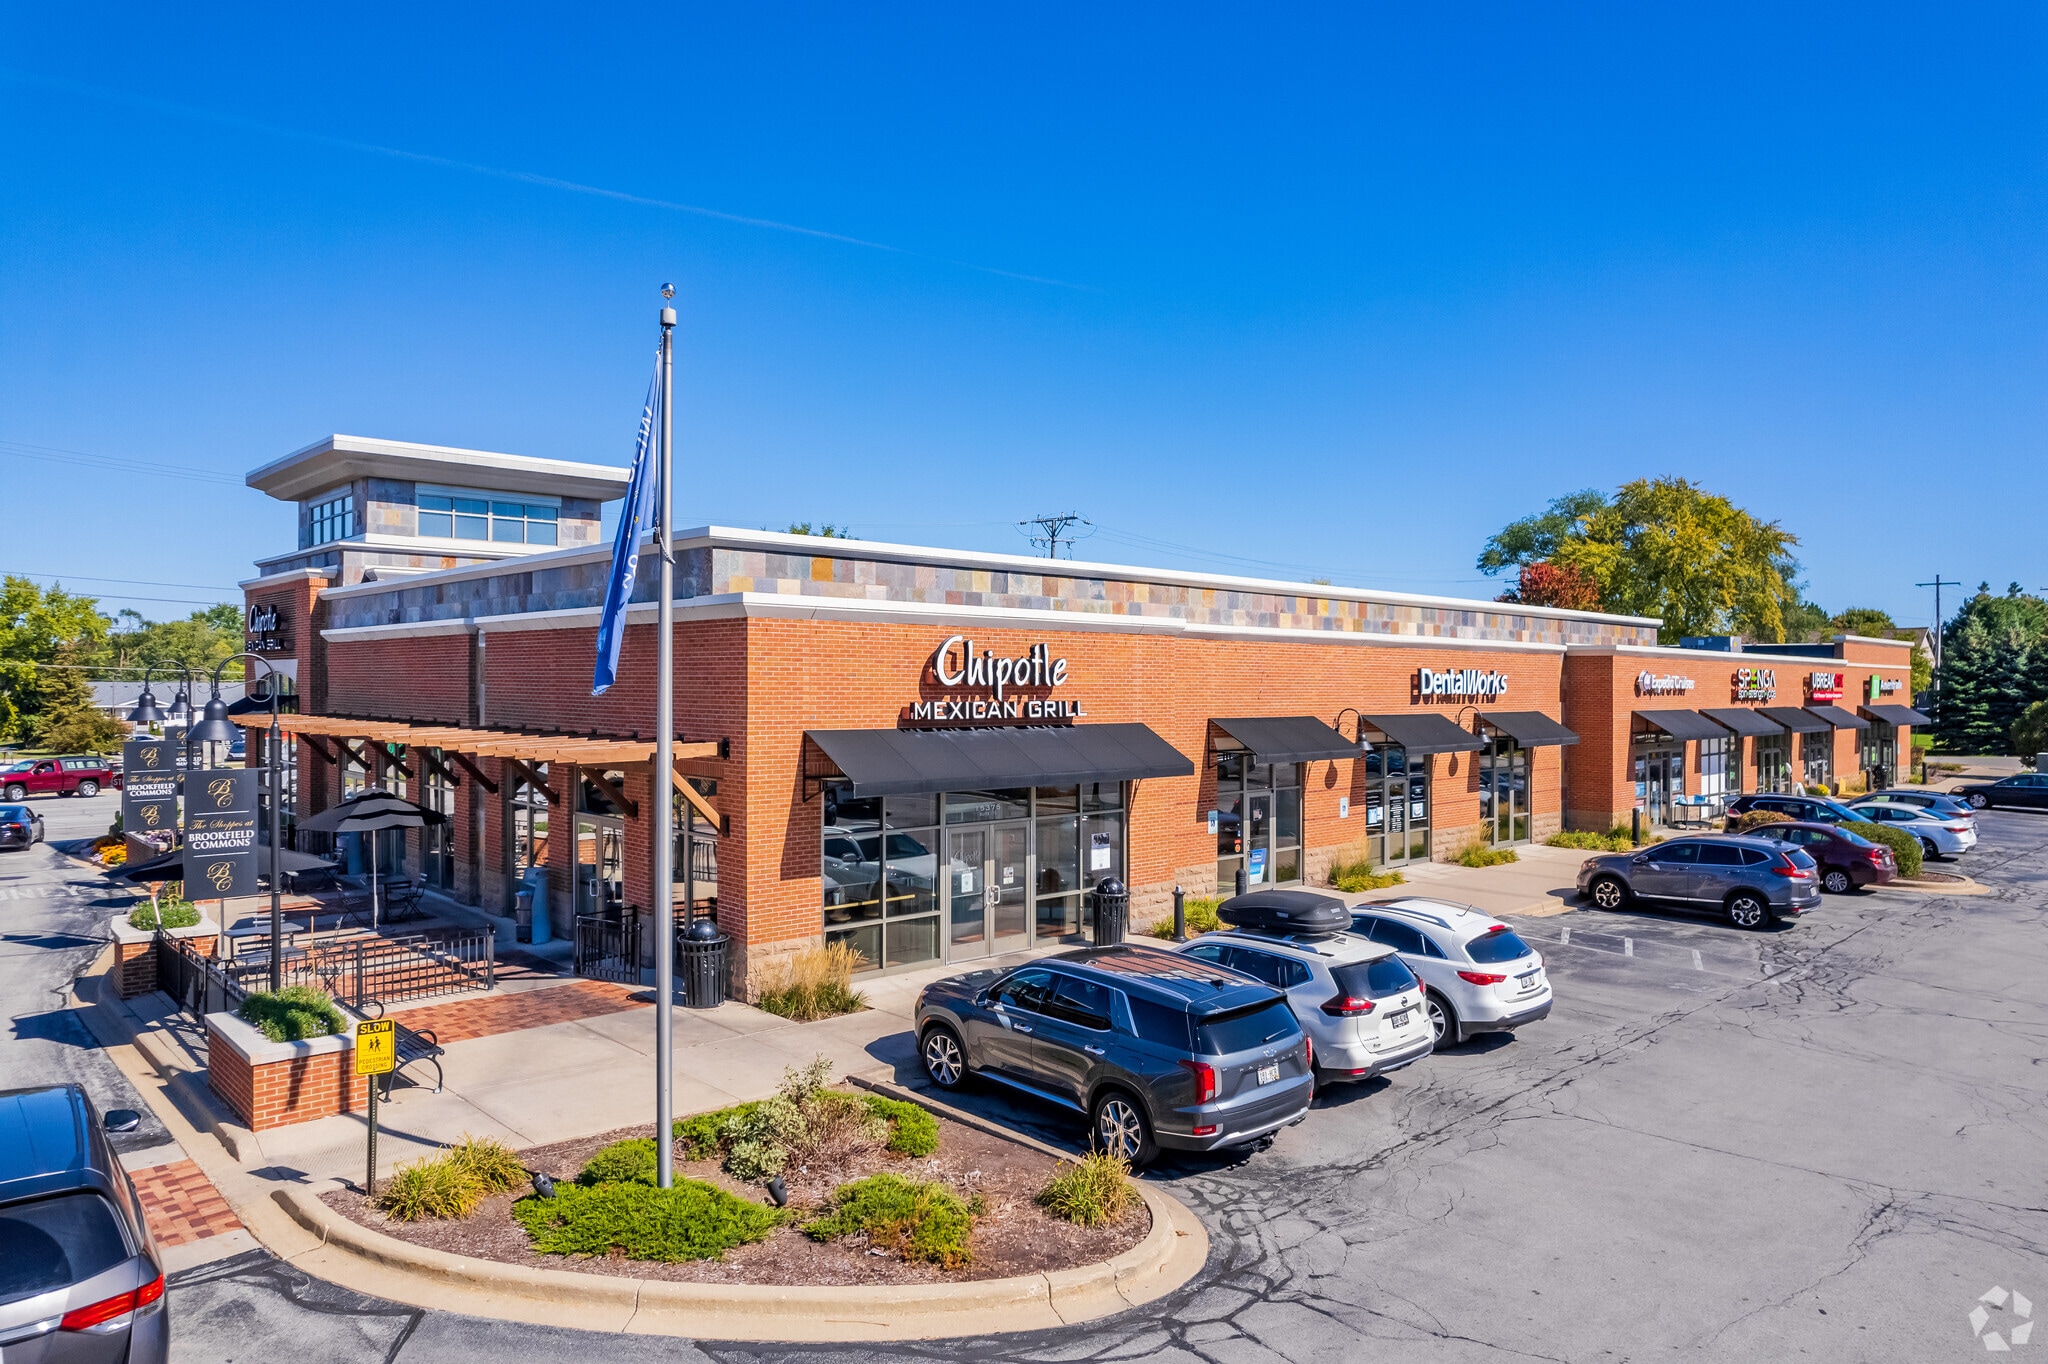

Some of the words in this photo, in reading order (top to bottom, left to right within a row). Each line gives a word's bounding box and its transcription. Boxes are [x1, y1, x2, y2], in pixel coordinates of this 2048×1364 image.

[934, 634, 1069, 701] Chipotle
[1420, 667, 1509, 695] DentalWorks
[1738, 668, 1777, 689] SPENGA
[913, 701, 1018, 720] MEXICAN
[1028, 700, 1088, 718] GRILL
[126, 783, 176, 792] BROOKFIELD
[129, 789, 173, 797] COMMONS
[188, 819, 207, 831] The
[188, 829, 255, 843] BROOKFIELD
[192, 837, 251, 850] COMMONS
[360, 1022, 390, 1034] SLOW
